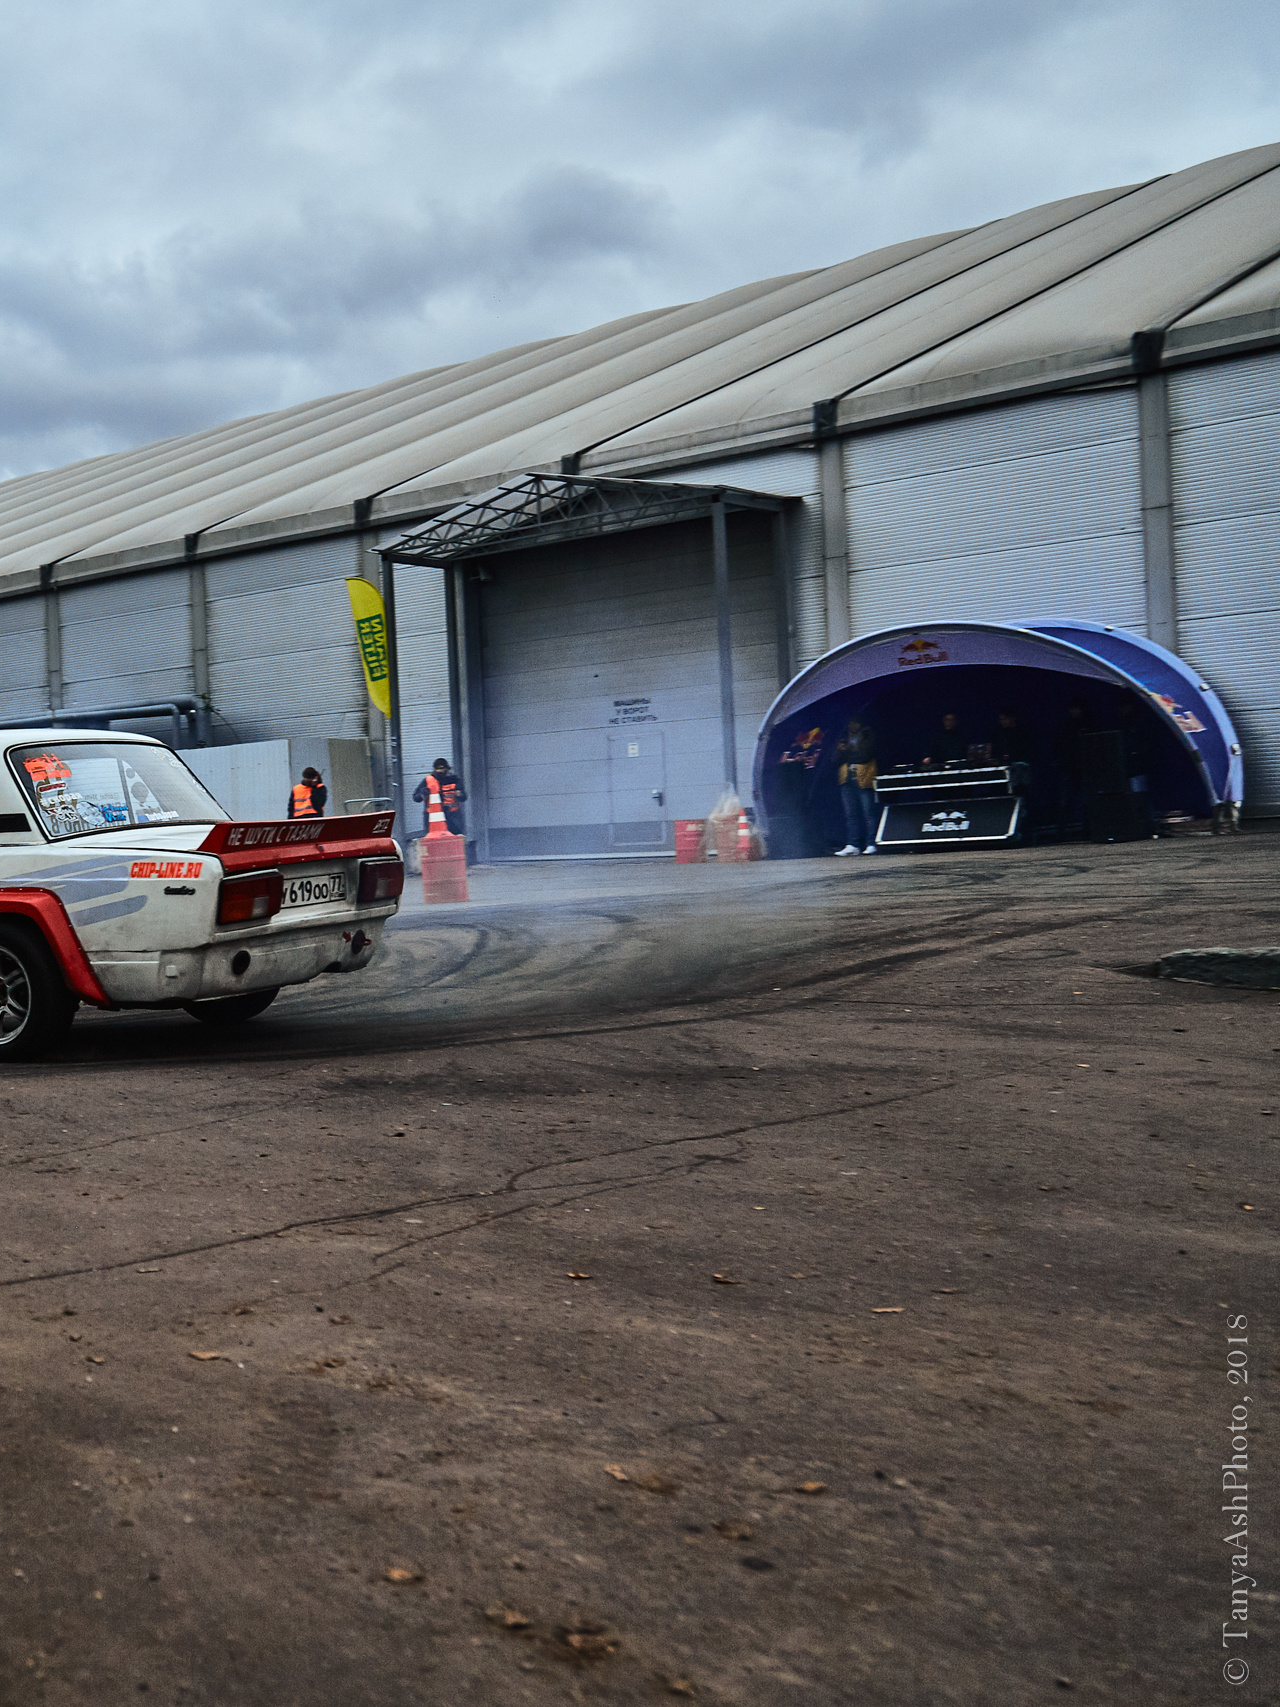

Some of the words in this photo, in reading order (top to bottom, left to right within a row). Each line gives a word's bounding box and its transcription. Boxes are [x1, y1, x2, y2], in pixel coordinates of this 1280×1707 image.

[898, 656, 919, 667] Red
[921, 823, 945, 832] Red
[946, 820, 970, 831] Bull
[228, 827, 245, 846] НЕ
[244, 825, 274, 845] ШУТИ
[276, 826, 283, 842] С
[285, 823, 326, 842] ТАЗАМИ
[130, 862, 203, 878] CHIP-LINE.RU
[330, 875, 342, 892] 77
